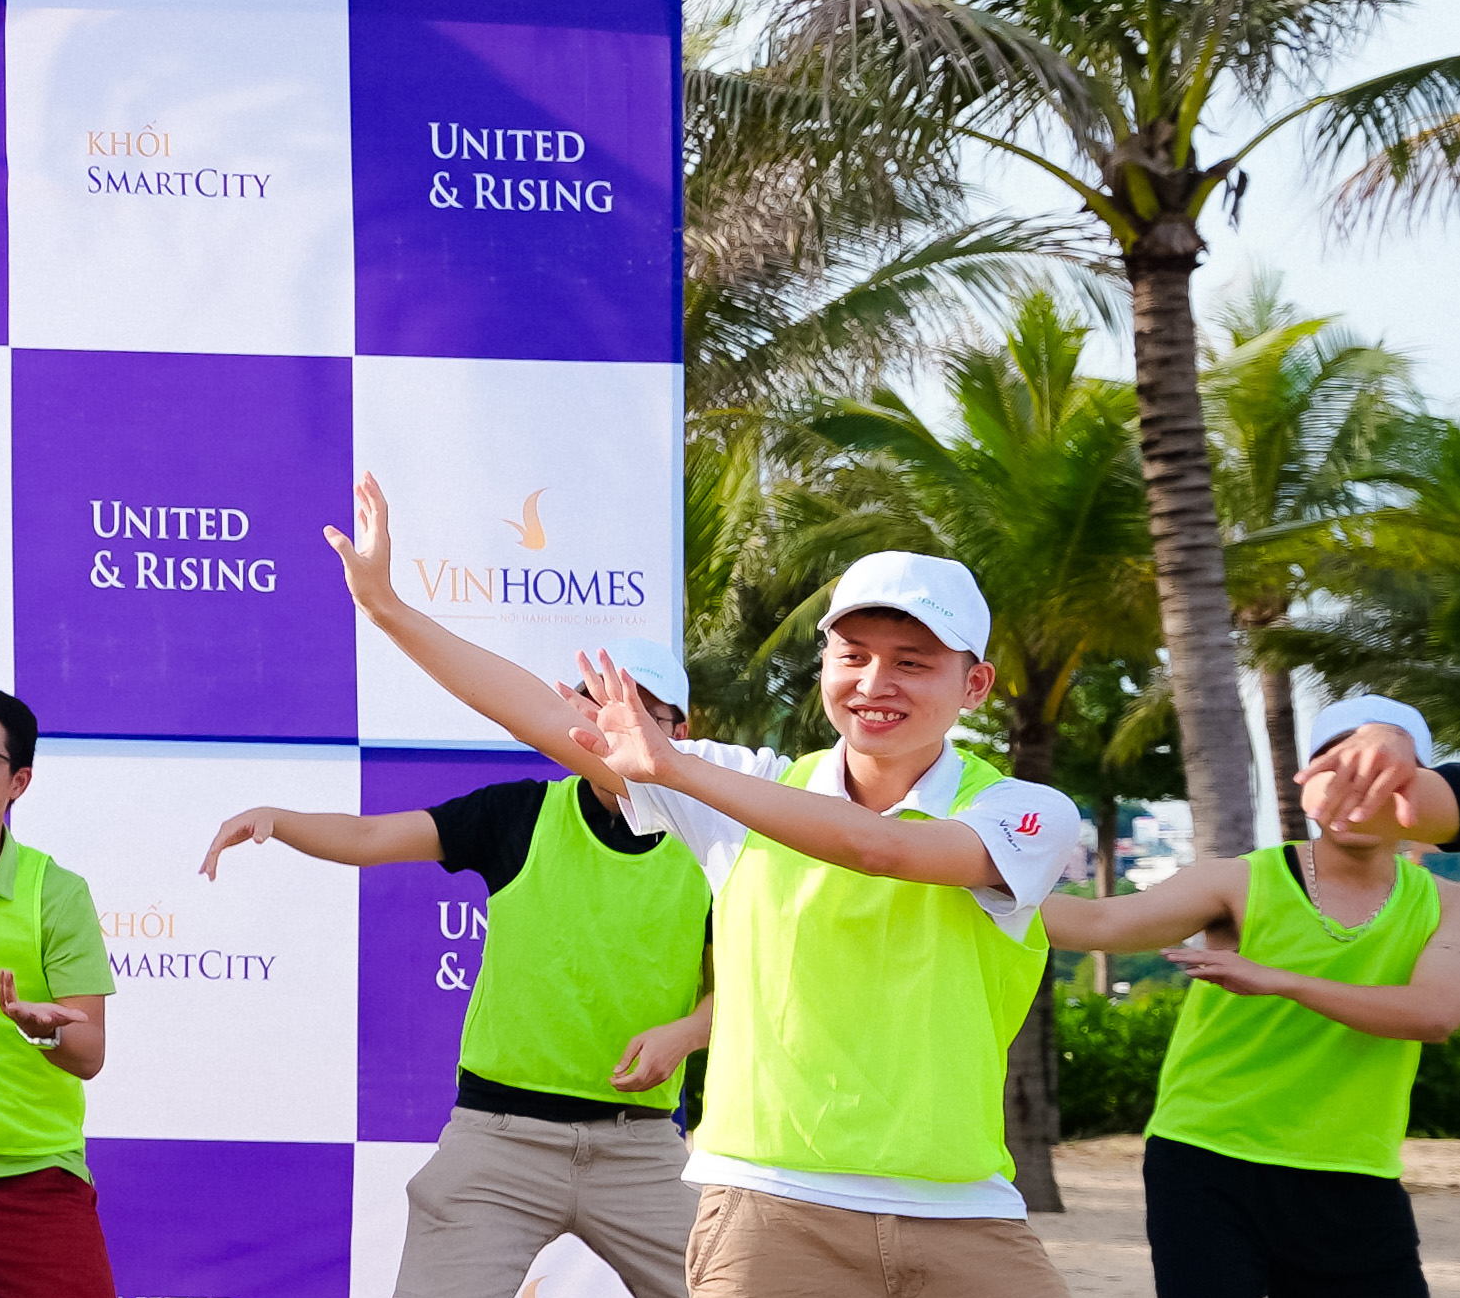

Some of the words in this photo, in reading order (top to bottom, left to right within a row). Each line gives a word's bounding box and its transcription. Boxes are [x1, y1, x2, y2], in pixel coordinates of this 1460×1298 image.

[87, 119, 172, 158] KHỐI
[430, 123, 585, 163] UNITED
[431, 172, 464, 209] &
[474, 174, 614, 213] RISING
[91, 501, 249, 543] UNITED
[92, 550, 126, 589] &
[136, 553, 277, 594] RISING
[413, 560, 645, 609] VINHOMES
[109, 951, 276, 981] MARTCITY
